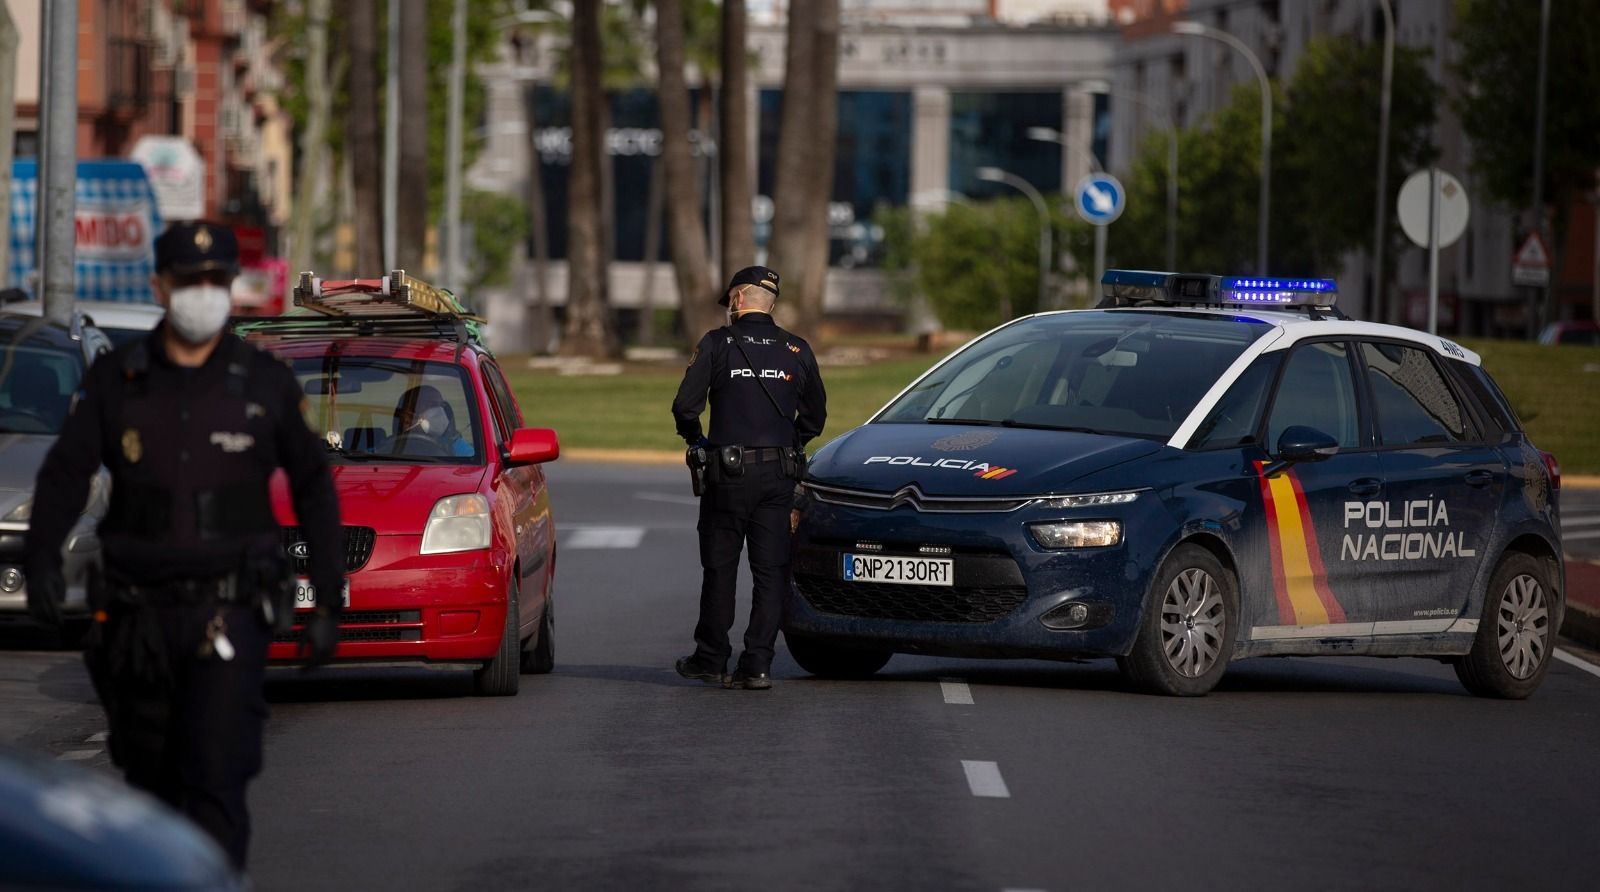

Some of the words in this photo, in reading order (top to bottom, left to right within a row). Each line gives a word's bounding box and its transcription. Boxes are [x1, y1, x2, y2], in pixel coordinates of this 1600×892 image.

[75, 215, 143, 247] MIDO
[863, 455, 990, 472] POLICÍA
[1344, 493, 1449, 528] POLICÍA
[294, 545, 308, 555] KI
[1340, 531, 1476, 561] NACIONAL
[1413, 607, 1458, 617] www.policia.es
